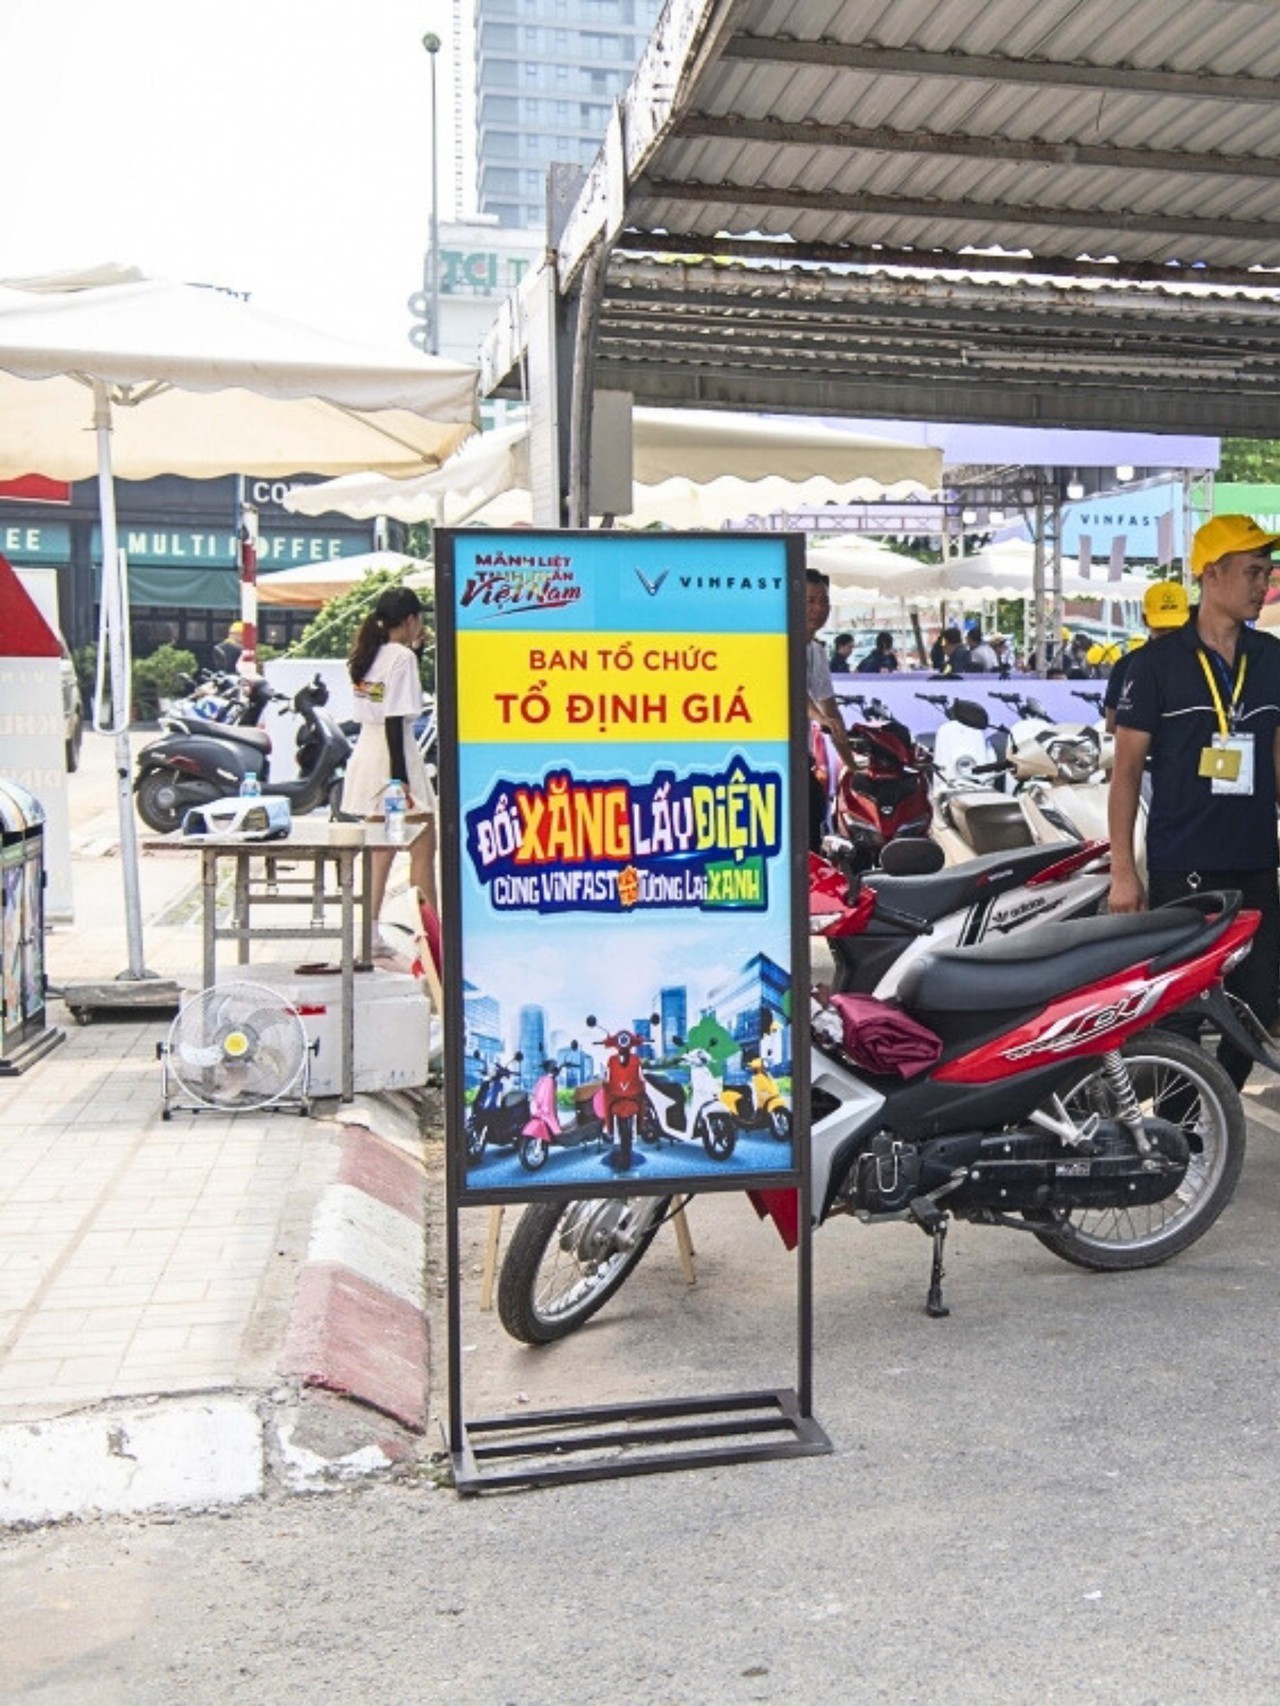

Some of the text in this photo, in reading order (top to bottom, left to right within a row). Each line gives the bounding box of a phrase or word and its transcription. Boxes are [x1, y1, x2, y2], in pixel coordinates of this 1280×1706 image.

[253, 481, 302, 504] CO
[3, 527, 41, 551] EE
[128, 532, 216, 557] MULTI
[680, 576, 783, 590] VINFAST
[529, 641, 717, 672] BAN TỔ CHỨC
[494, 679, 752, 733] TỔ ĐỊNH GIÁ
[516, 775, 631, 863] XĂNG
[632, 781, 694, 856] LẤY
[494, 873, 540, 903] CÙNG
[708, 868, 760, 901] XANH
